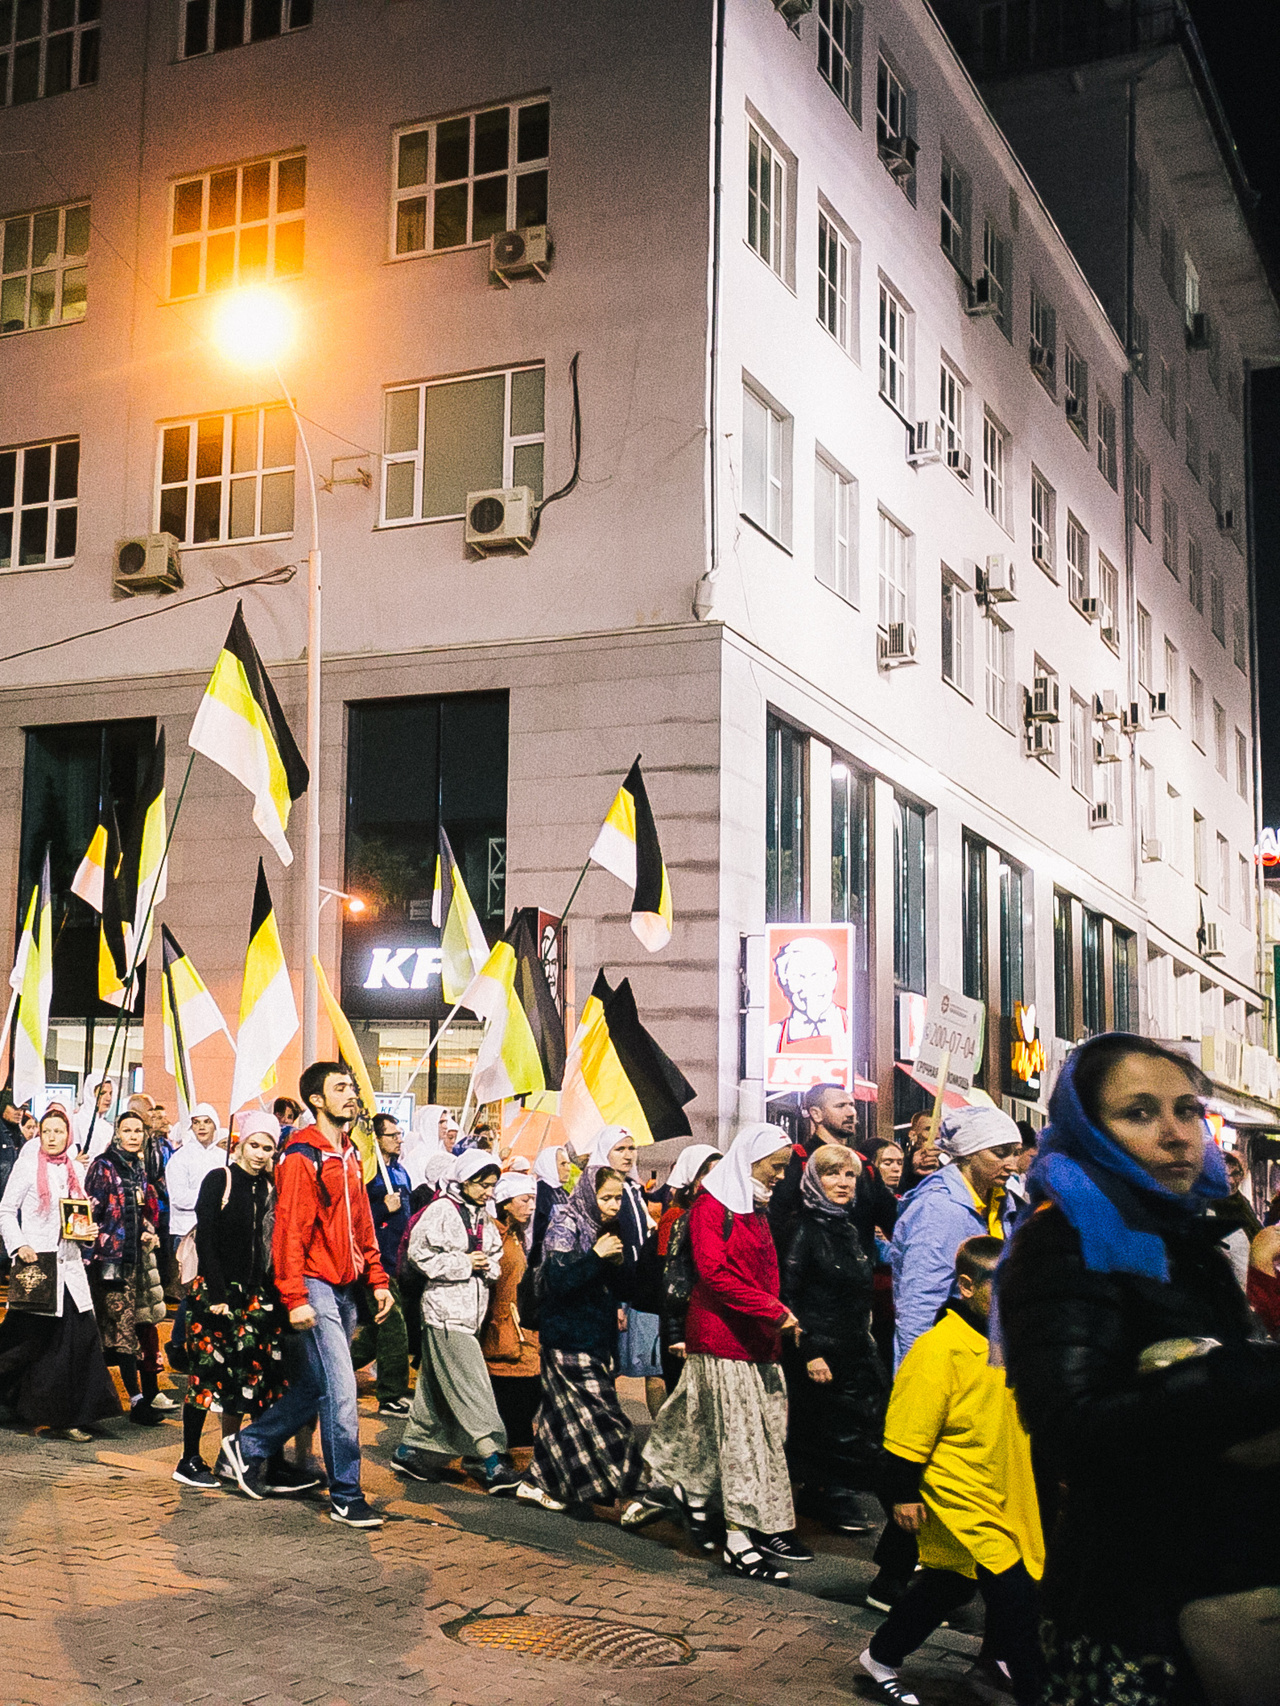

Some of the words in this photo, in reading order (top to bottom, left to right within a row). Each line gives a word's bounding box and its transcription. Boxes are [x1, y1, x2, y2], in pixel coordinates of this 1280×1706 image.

[363, 947, 443, 989] KF
[929, 1023, 976, 1060] 200-07-04
[770, 1059, 848, 1084] KFC
